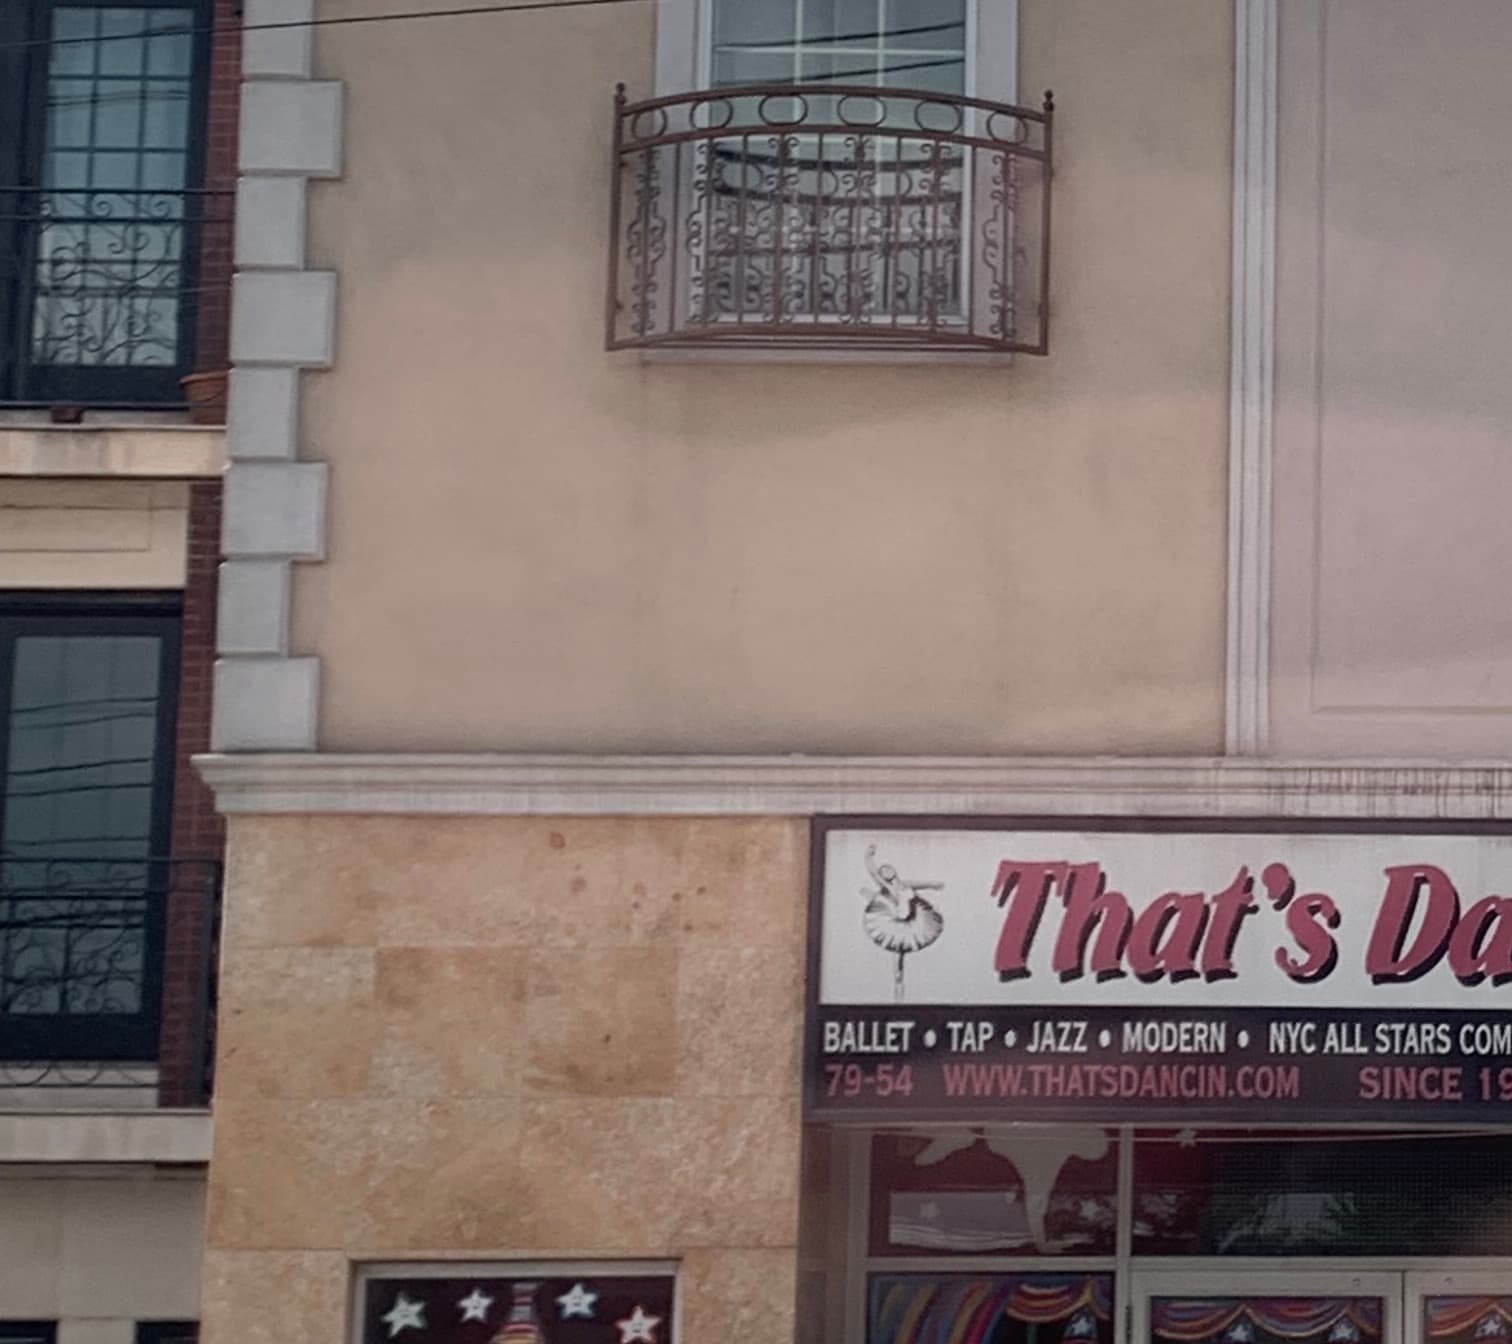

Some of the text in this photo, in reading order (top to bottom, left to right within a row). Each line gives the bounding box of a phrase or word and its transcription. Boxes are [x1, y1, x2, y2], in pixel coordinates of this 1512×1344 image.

[990, 859, 1341, 985] That's
[823, 1020, 915, 1054] BALLET
[946, 1021, 995, 1053] TAP
[1026, 1021, 1088, 1053] JAZZ
[1121, 1021, 1226, 1054] MODERN
[1268, 1022, 1317, 1054] NYC
[1323, 1023, 1369, 1054] ALL
[1375, 1023, 1452, 1055] STARS
[825, 1064, 913, 1097] 79-54
[943, 1064, 1299, 1099] WWW.THATSDANCIN.COM
[1358, 1067, 1463, 1100] SINCE
